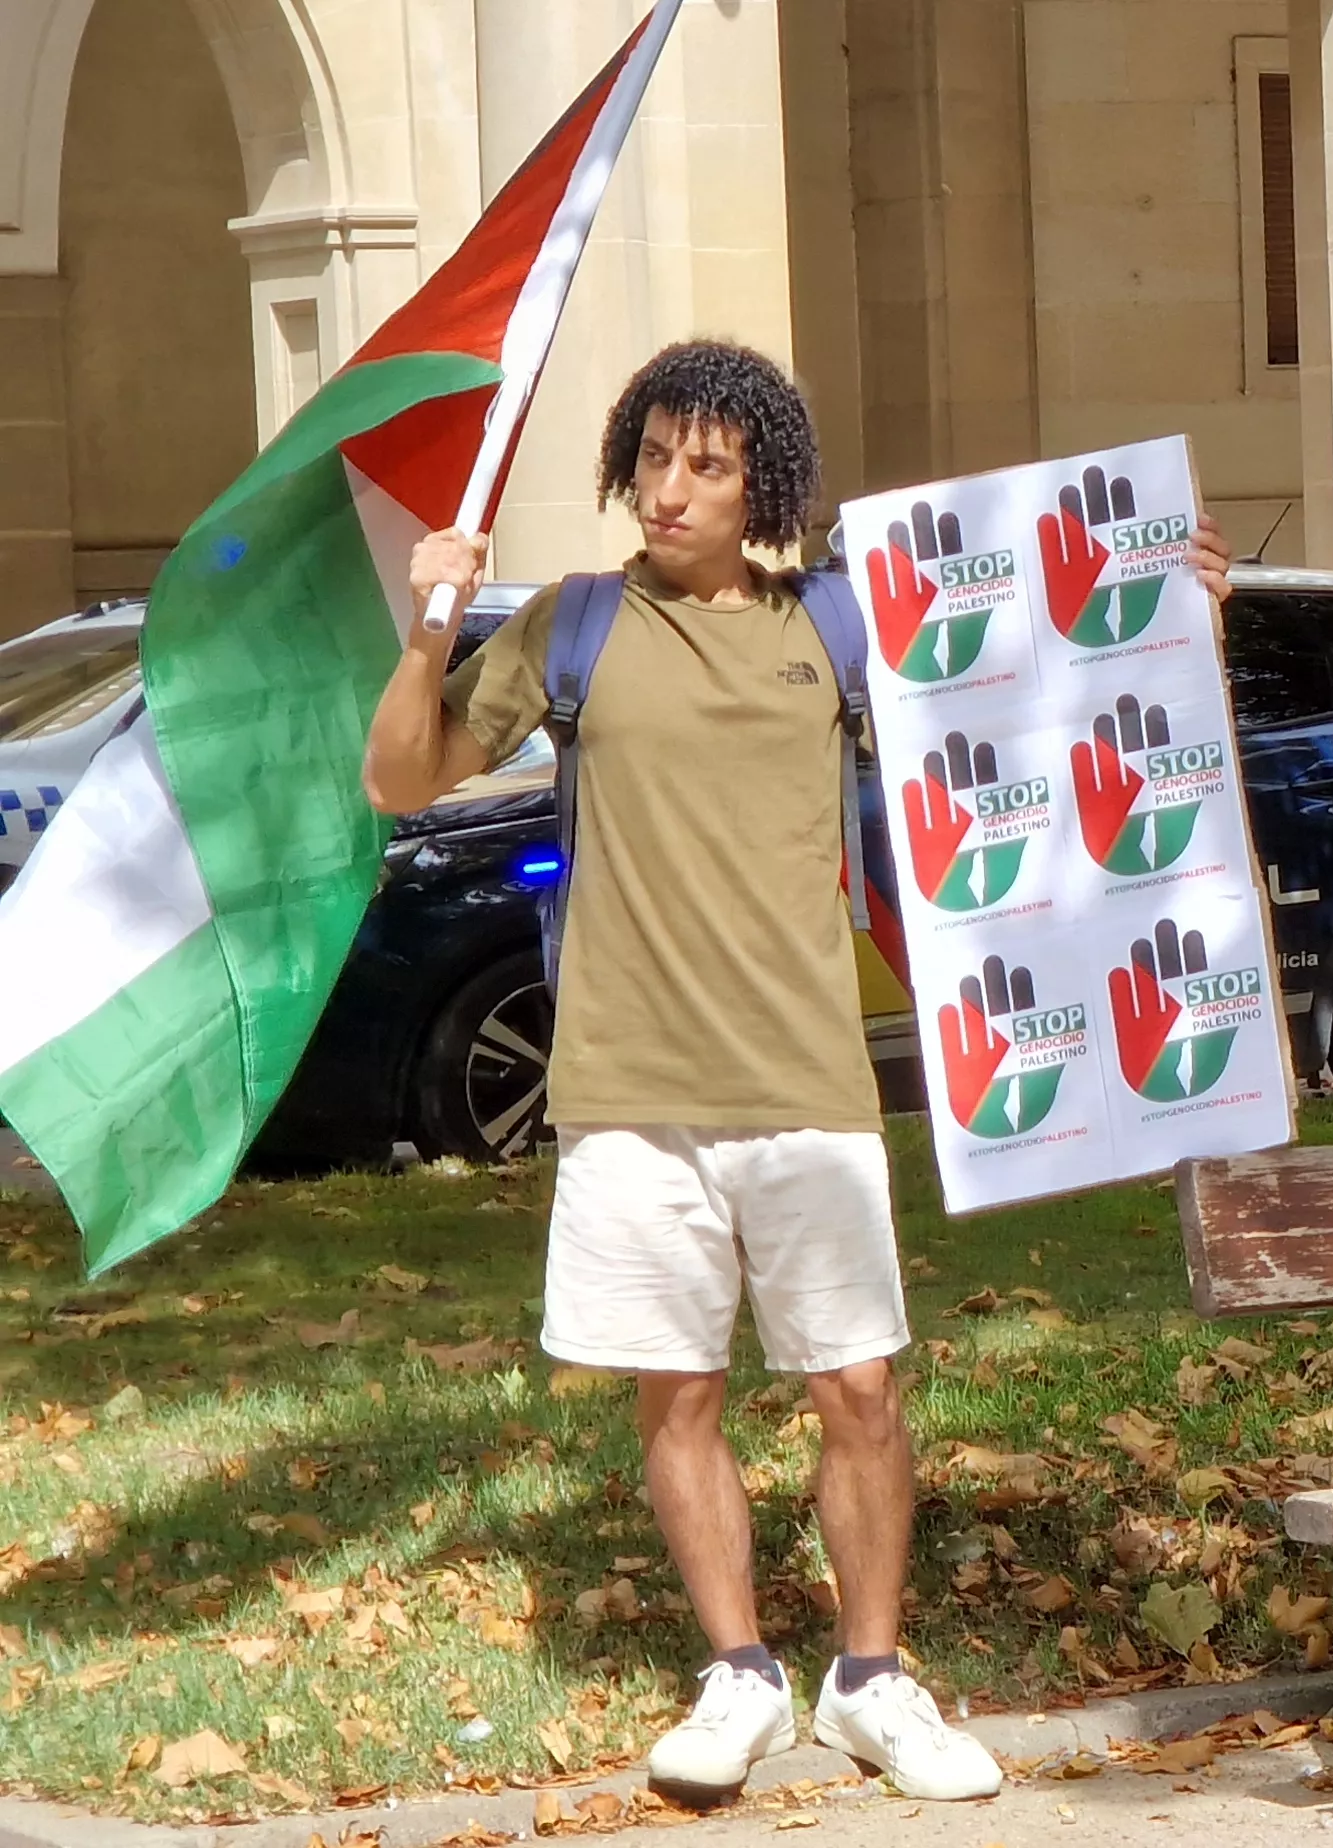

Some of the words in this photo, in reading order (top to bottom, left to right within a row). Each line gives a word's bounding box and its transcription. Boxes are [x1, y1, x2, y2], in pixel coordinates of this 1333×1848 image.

[1114, 515, 1186, 552] STOP
[1119, 541, 1187, 564] GENOCIDIO
[942, 551, 1012, 588] STOP
[947, 577, 1013, 599] GENOCIDIO
[948, 590, 1015, 613] PALESTINO
[1149, 743, 1220, 779] STOP
[1154, 768, 1222, 791] GENOCIDIO
[977, 780, 1047, 817] STOP
[1155, 782, 1225, 805] PALESTINO
[983, 804, 1048, 828] GENOCIDIO
[984, 817, 1050, 842] PALESTINO
[1277, 951, 1319, 970] licia
[1187, 970, 1258, 1006] STOP
[1191, 995, 1259, 1017] GENOCIDIO
[1014, 1006, 1083, 1043] STOP
[1193, 1008, 1262, 1032] PALESTINO
[1019, 1031, 1085, 1055] GENOCIDIO
[1020, 1045, 1087, 1068] PALESTINO
